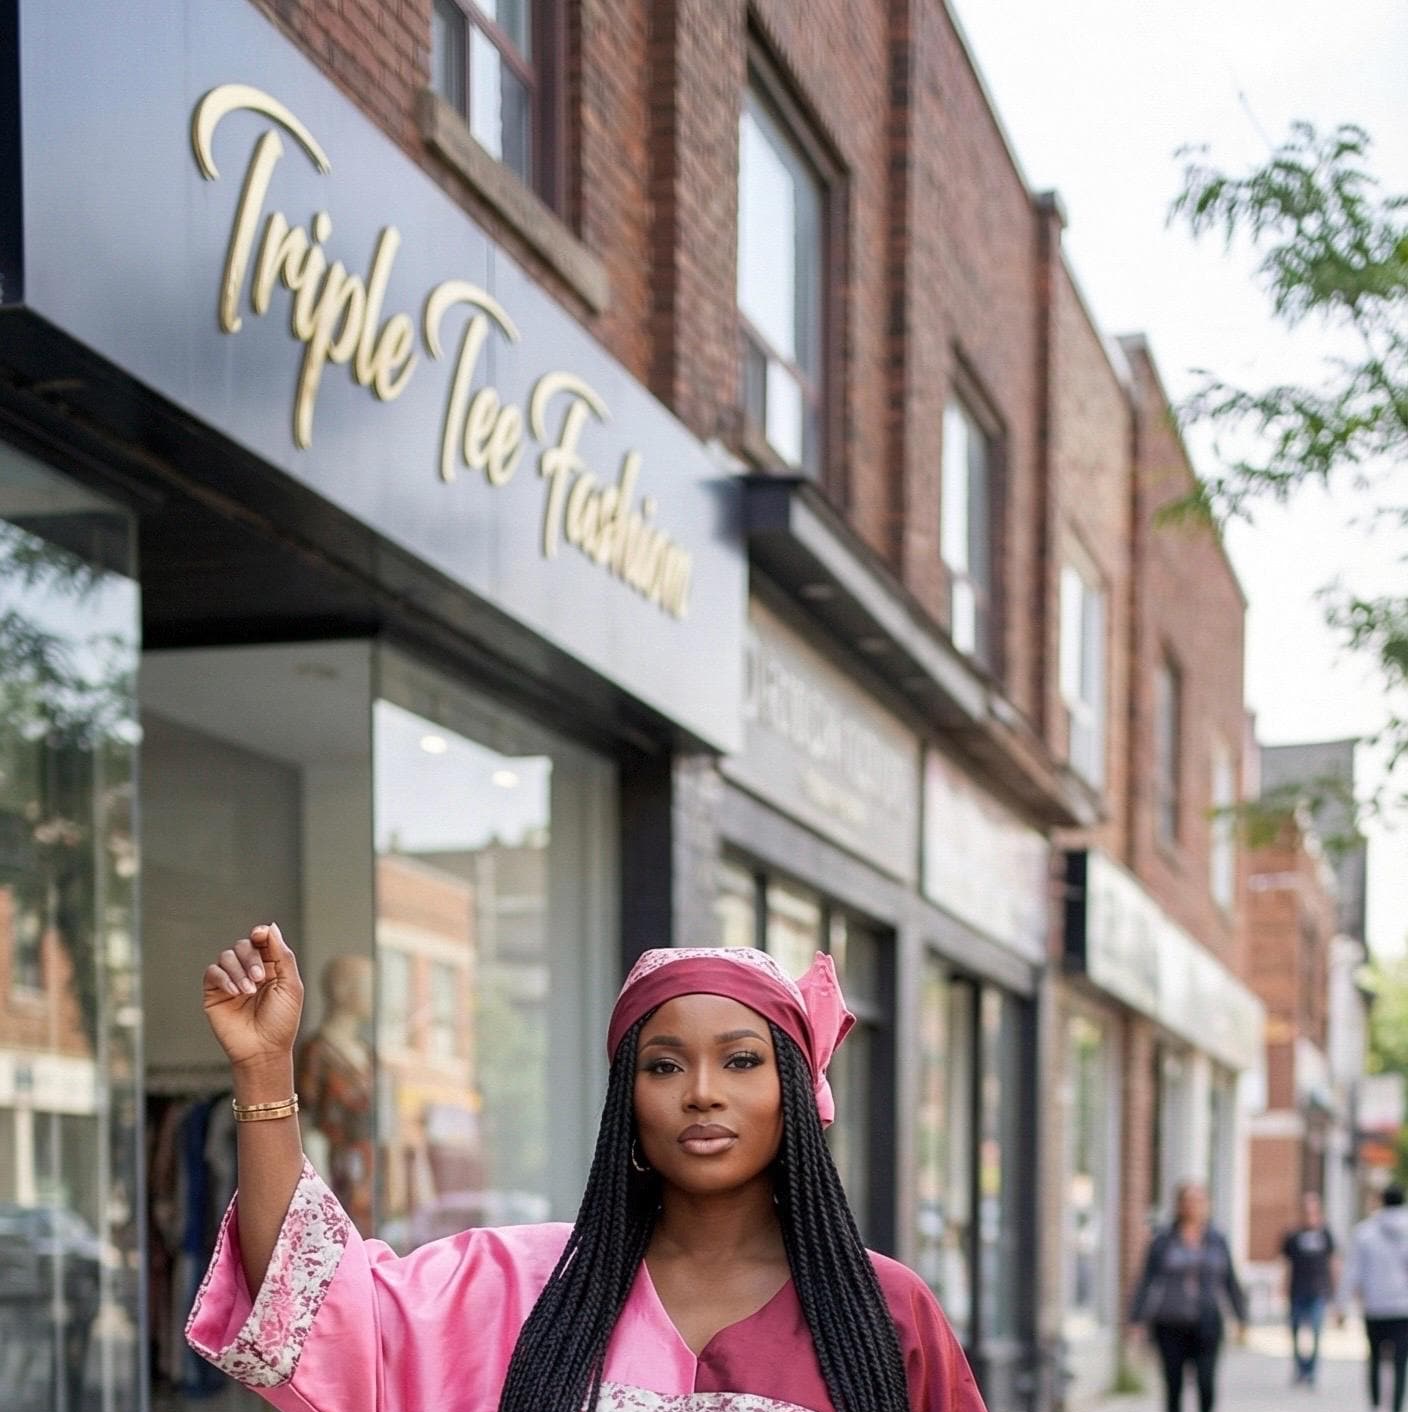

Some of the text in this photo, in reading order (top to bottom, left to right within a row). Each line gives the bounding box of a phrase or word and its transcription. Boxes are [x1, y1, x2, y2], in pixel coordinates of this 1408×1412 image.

[191, 84, 692, 620] Triple Tee Fashion
